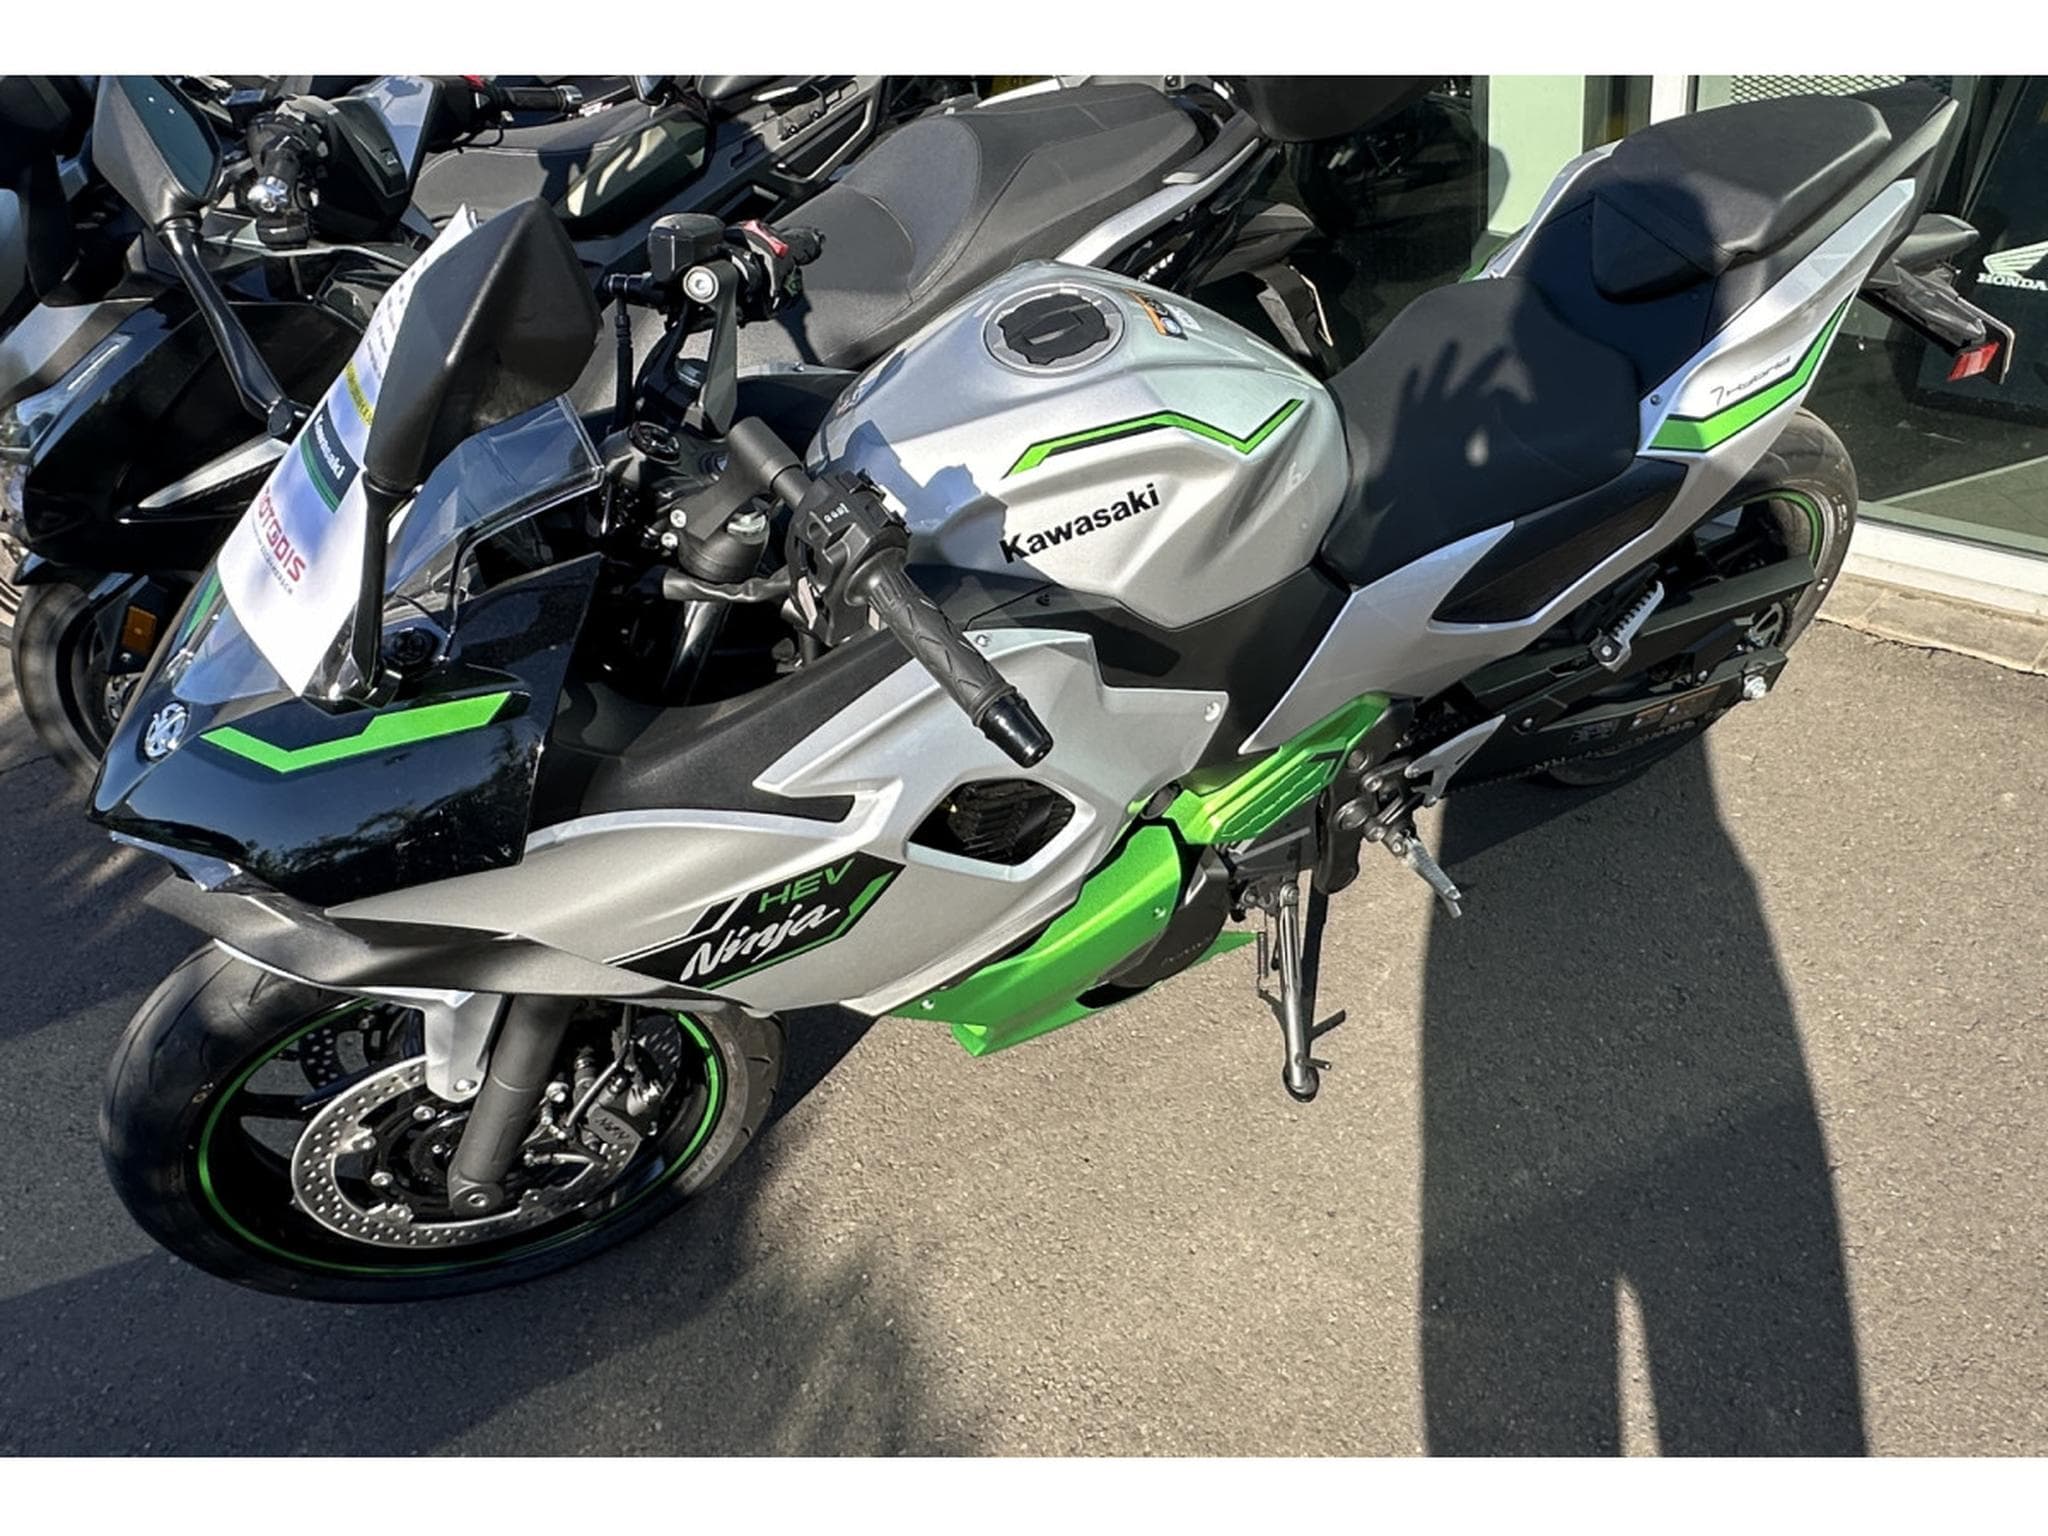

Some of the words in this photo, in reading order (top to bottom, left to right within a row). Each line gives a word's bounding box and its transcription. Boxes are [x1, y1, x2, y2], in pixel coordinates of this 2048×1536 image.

[1976, 272, 2048, 291] HONDA
[999, 482, 1160, 564] Kawasaki
[758, 857, 855, 914] HEV
[679, 903, 841, 982] Ninja
